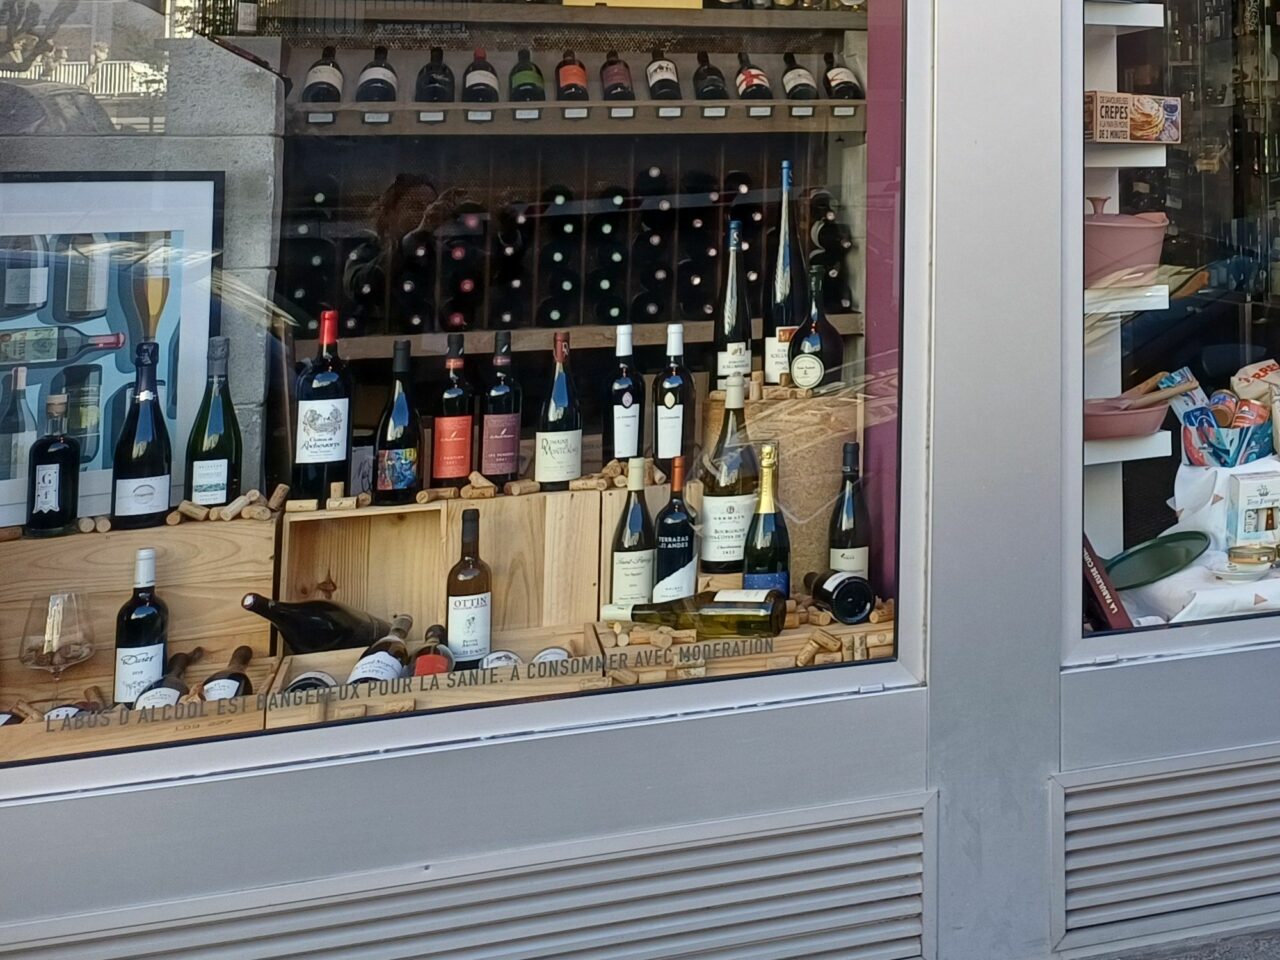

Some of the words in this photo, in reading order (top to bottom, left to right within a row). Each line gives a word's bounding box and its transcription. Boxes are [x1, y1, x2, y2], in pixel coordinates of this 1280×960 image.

[454, 596, 487, 608] OTTIN
[217, 697, 247, 716] EST
[368, 679, 412, 698] POUR
[420, 674, 440, 692] LA
[527, 653, 629, 680] CONSOMMER
[635, 647, 674, 668] AVEC
[679, 637, 775, 663] MODERATION
